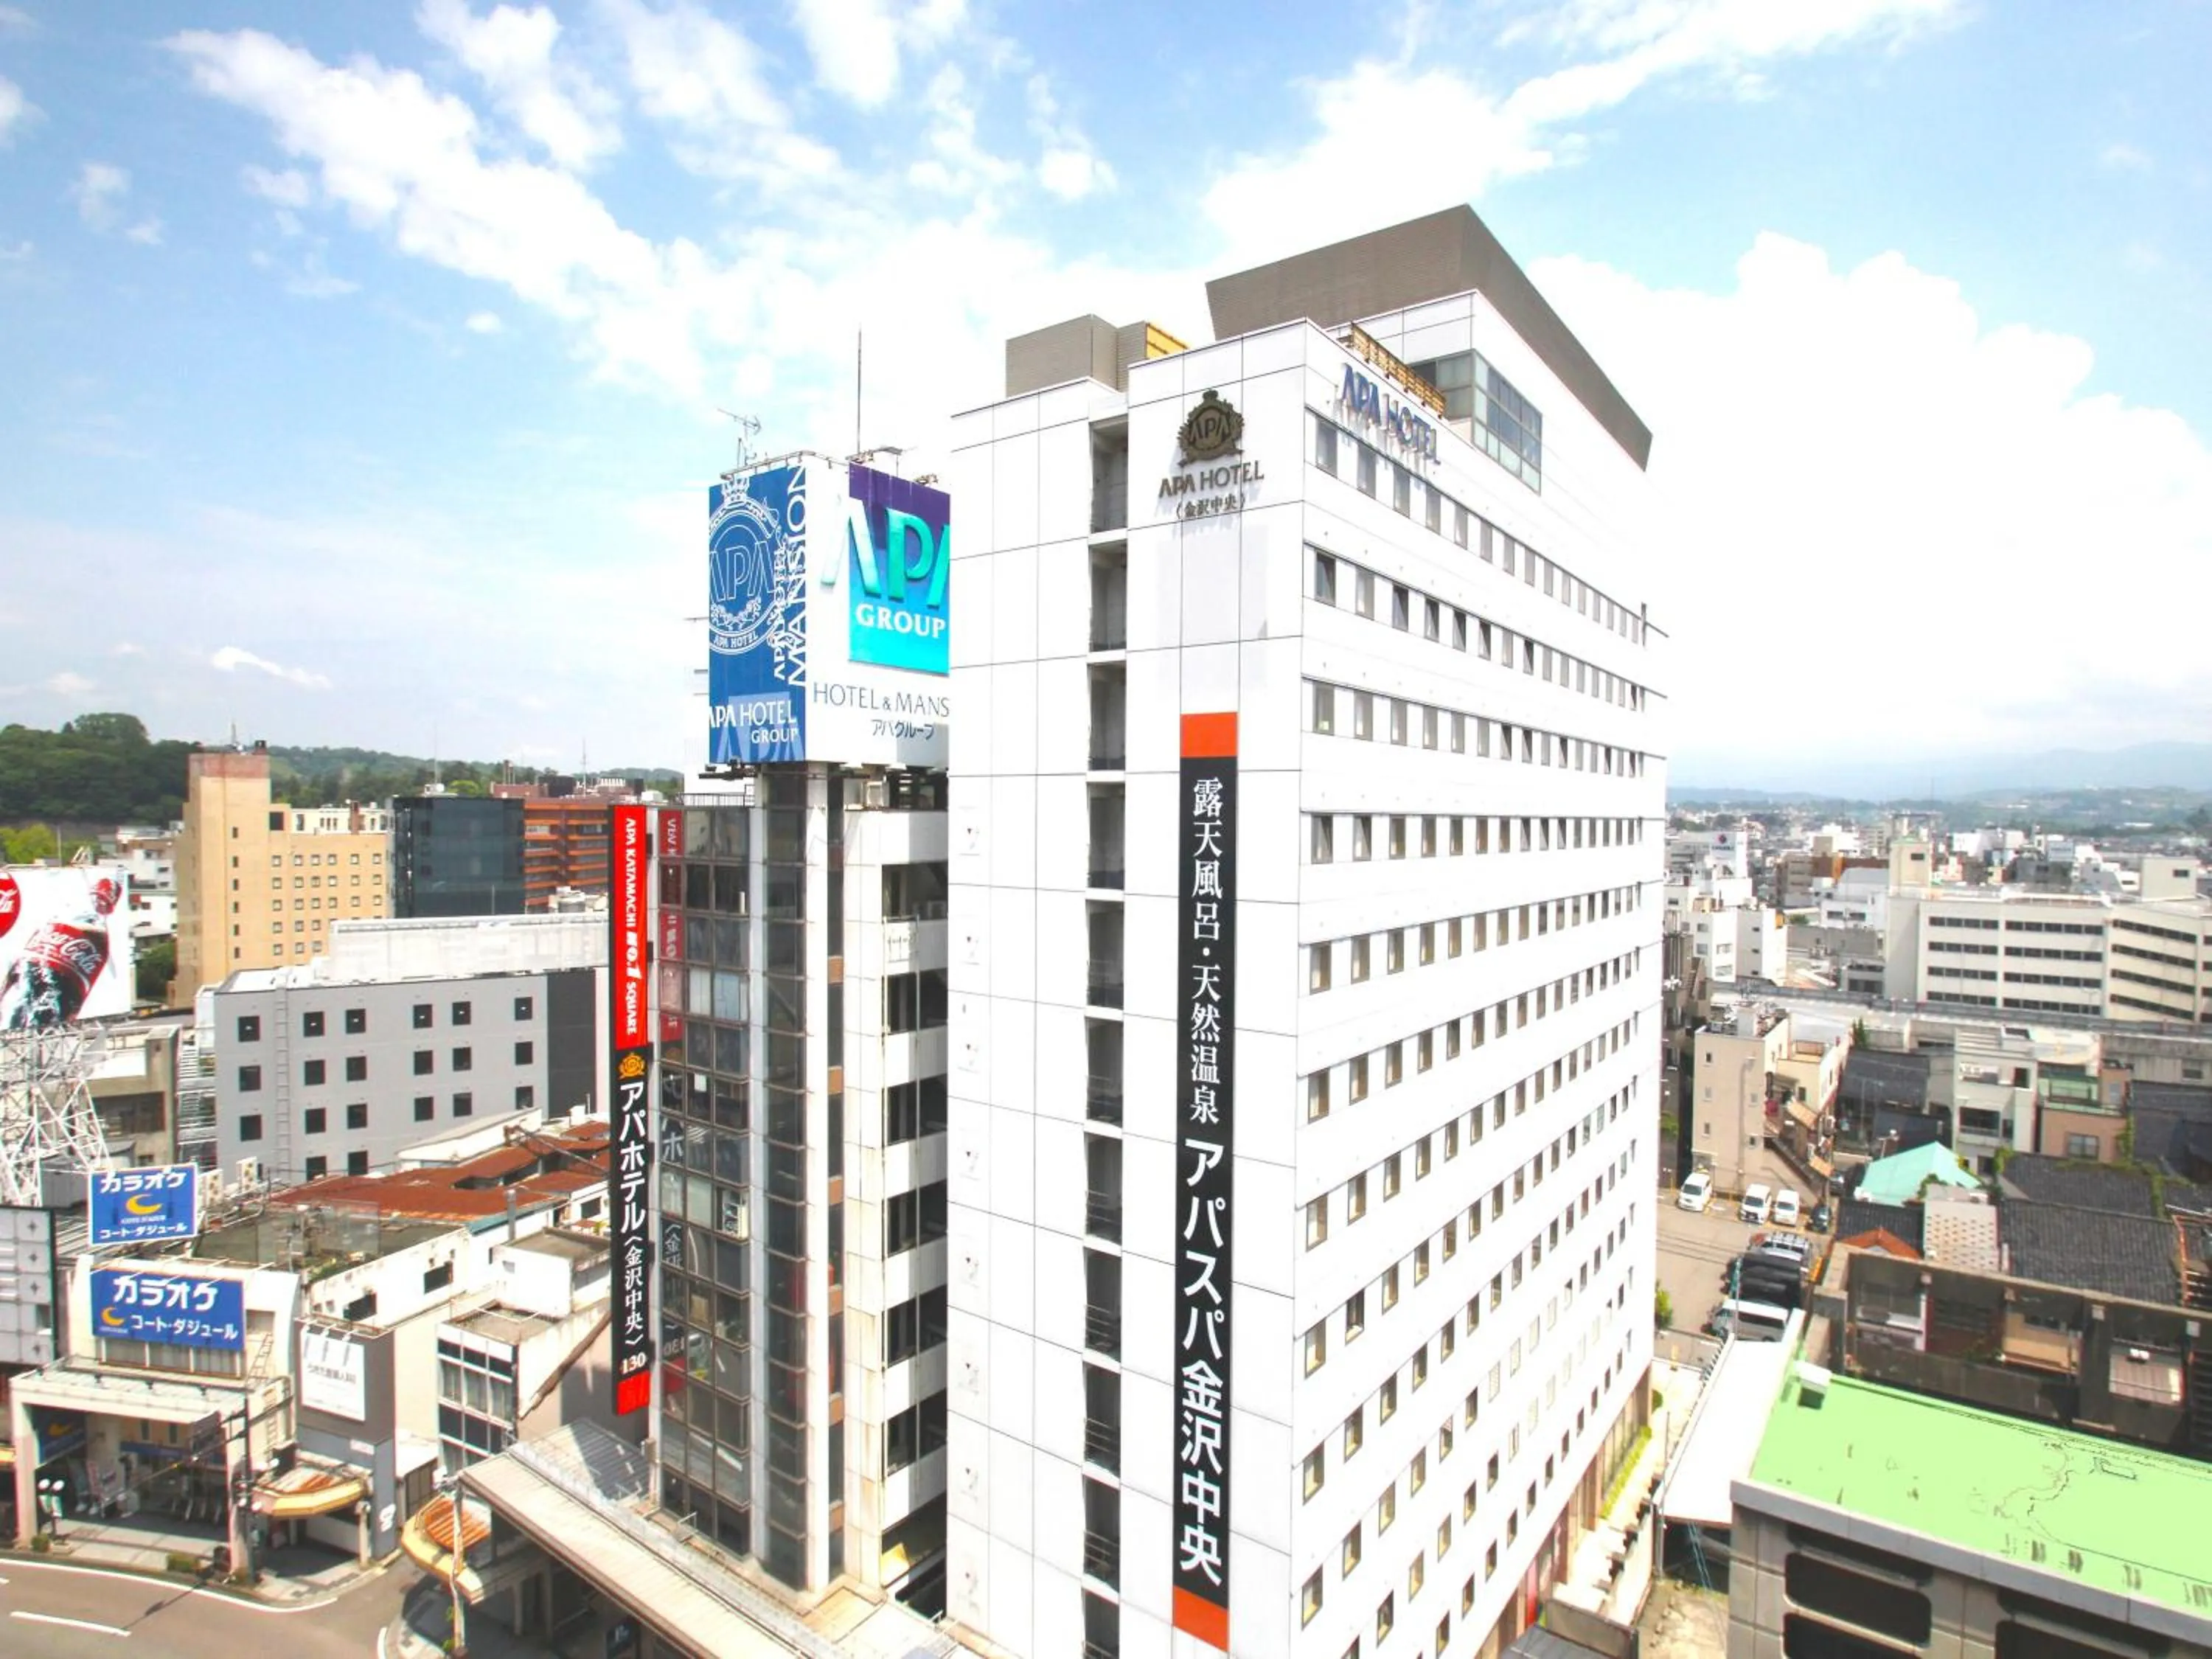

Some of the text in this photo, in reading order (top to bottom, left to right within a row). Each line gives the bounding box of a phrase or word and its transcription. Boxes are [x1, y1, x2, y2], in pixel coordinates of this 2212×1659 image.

[1159, 460, 1265, 498] APA HOTEL
[855, 603, 946, 640] GROUP
[731, 632, 759, 648] HOTEL
[813, 682, 880, 710] HOTEL
[883, 700, 891, 712] &
[740, 700, 797, 727] HOTEL
[751, 728, 799, 744] GROUP
[625, 818, 636, 846] APA
[625, 849, 637, 928] KATAMACHI
[625, 989, 637, 1035] SQUARE
[100, 1169, 187, 1193] カラオケ
[113, 1276, 218, 1311] カラオケ
[131, 1315, 238, 1340] コート・ダジュール
[621, 1354, 647, 1374] 130
[1180, 1138, 1225, 1587] アパスパ金沢中央
